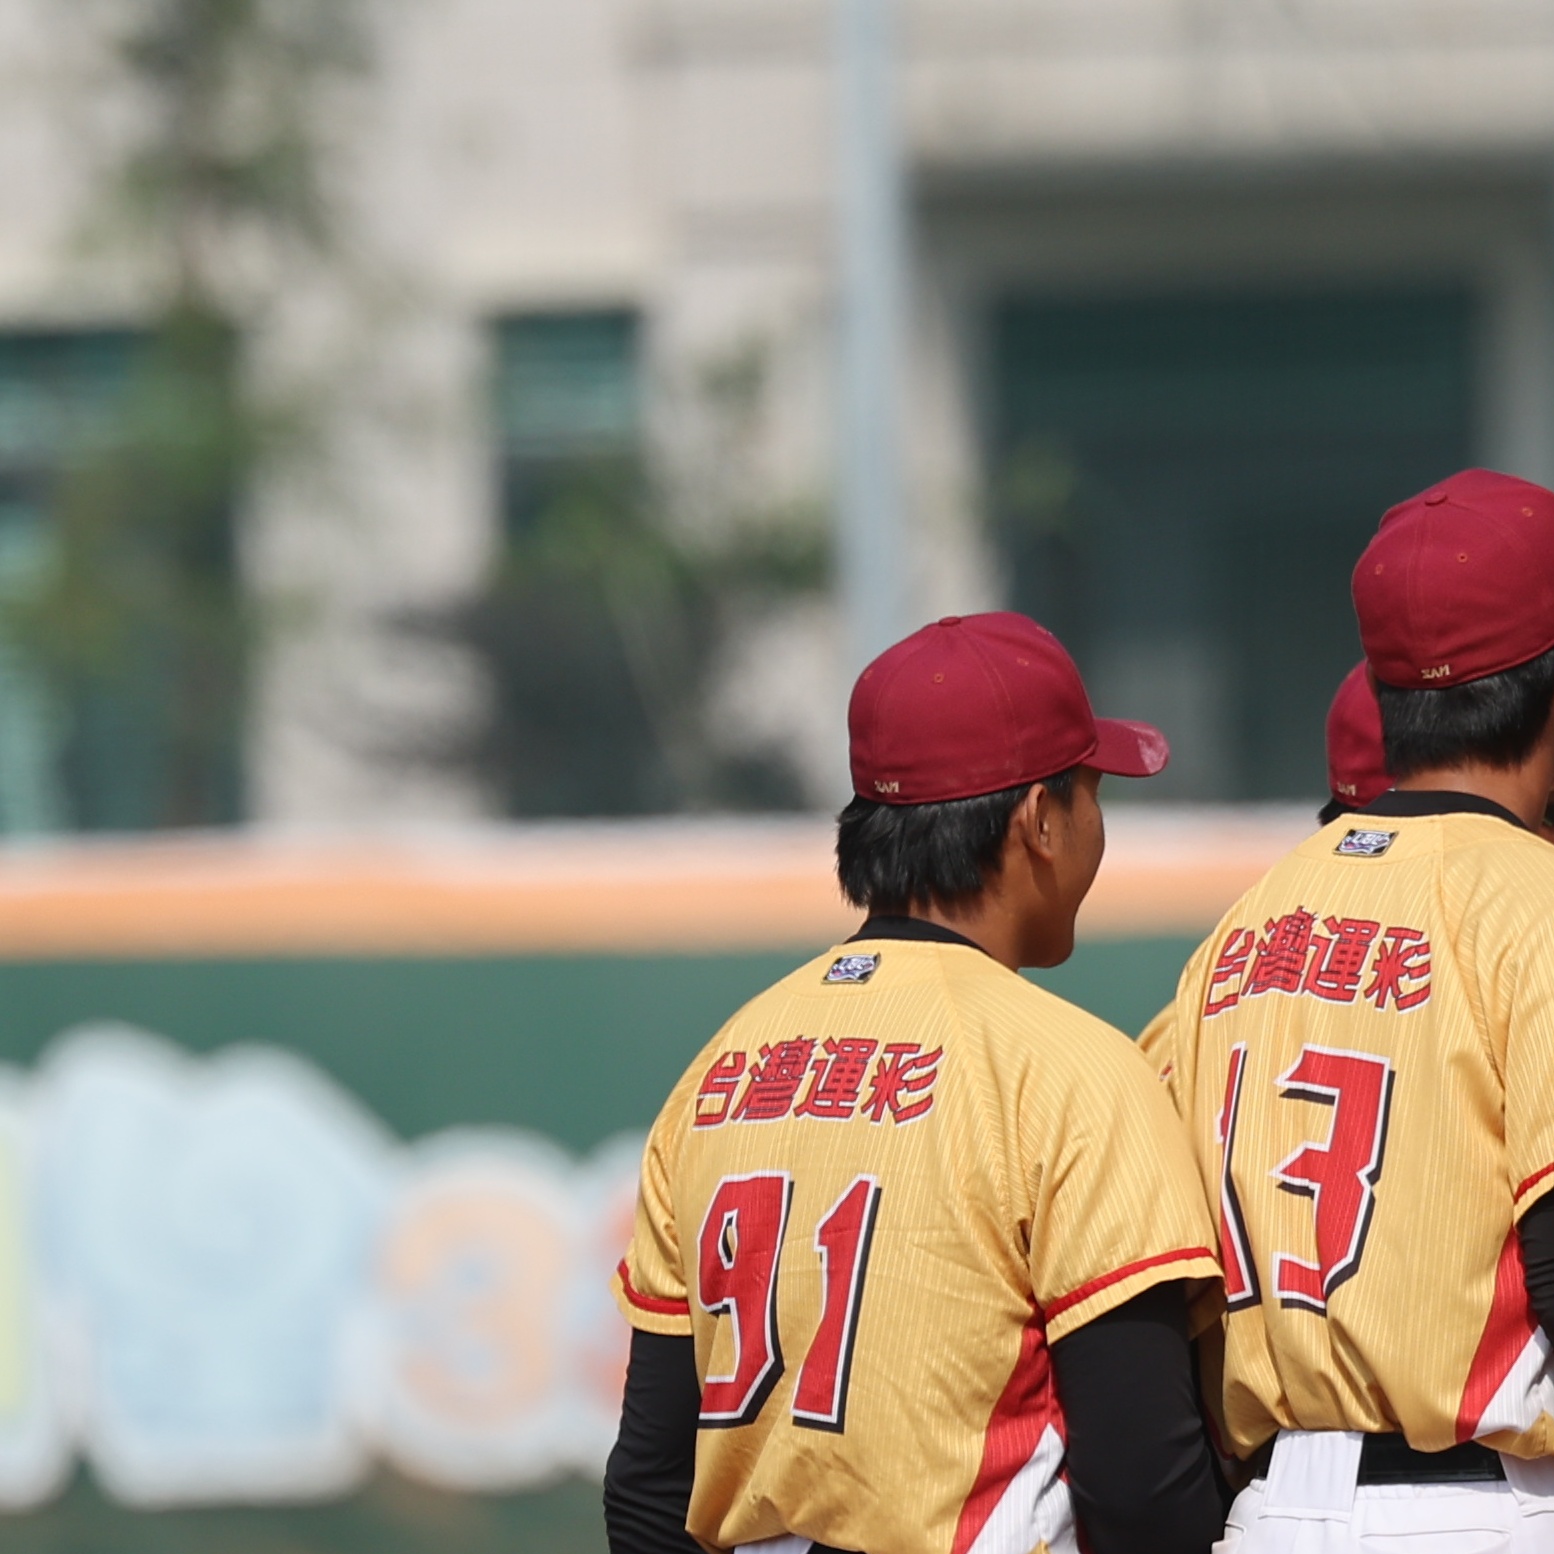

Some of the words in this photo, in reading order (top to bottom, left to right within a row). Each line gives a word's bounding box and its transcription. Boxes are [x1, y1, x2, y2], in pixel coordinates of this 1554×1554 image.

[1421, 663, 1451, 680] SAM
[693, 1035, 943, 1131] 台灣運彩
[1215, 1040, 1396, 1318] 13
[697, 1169, 882, 1434] 91
